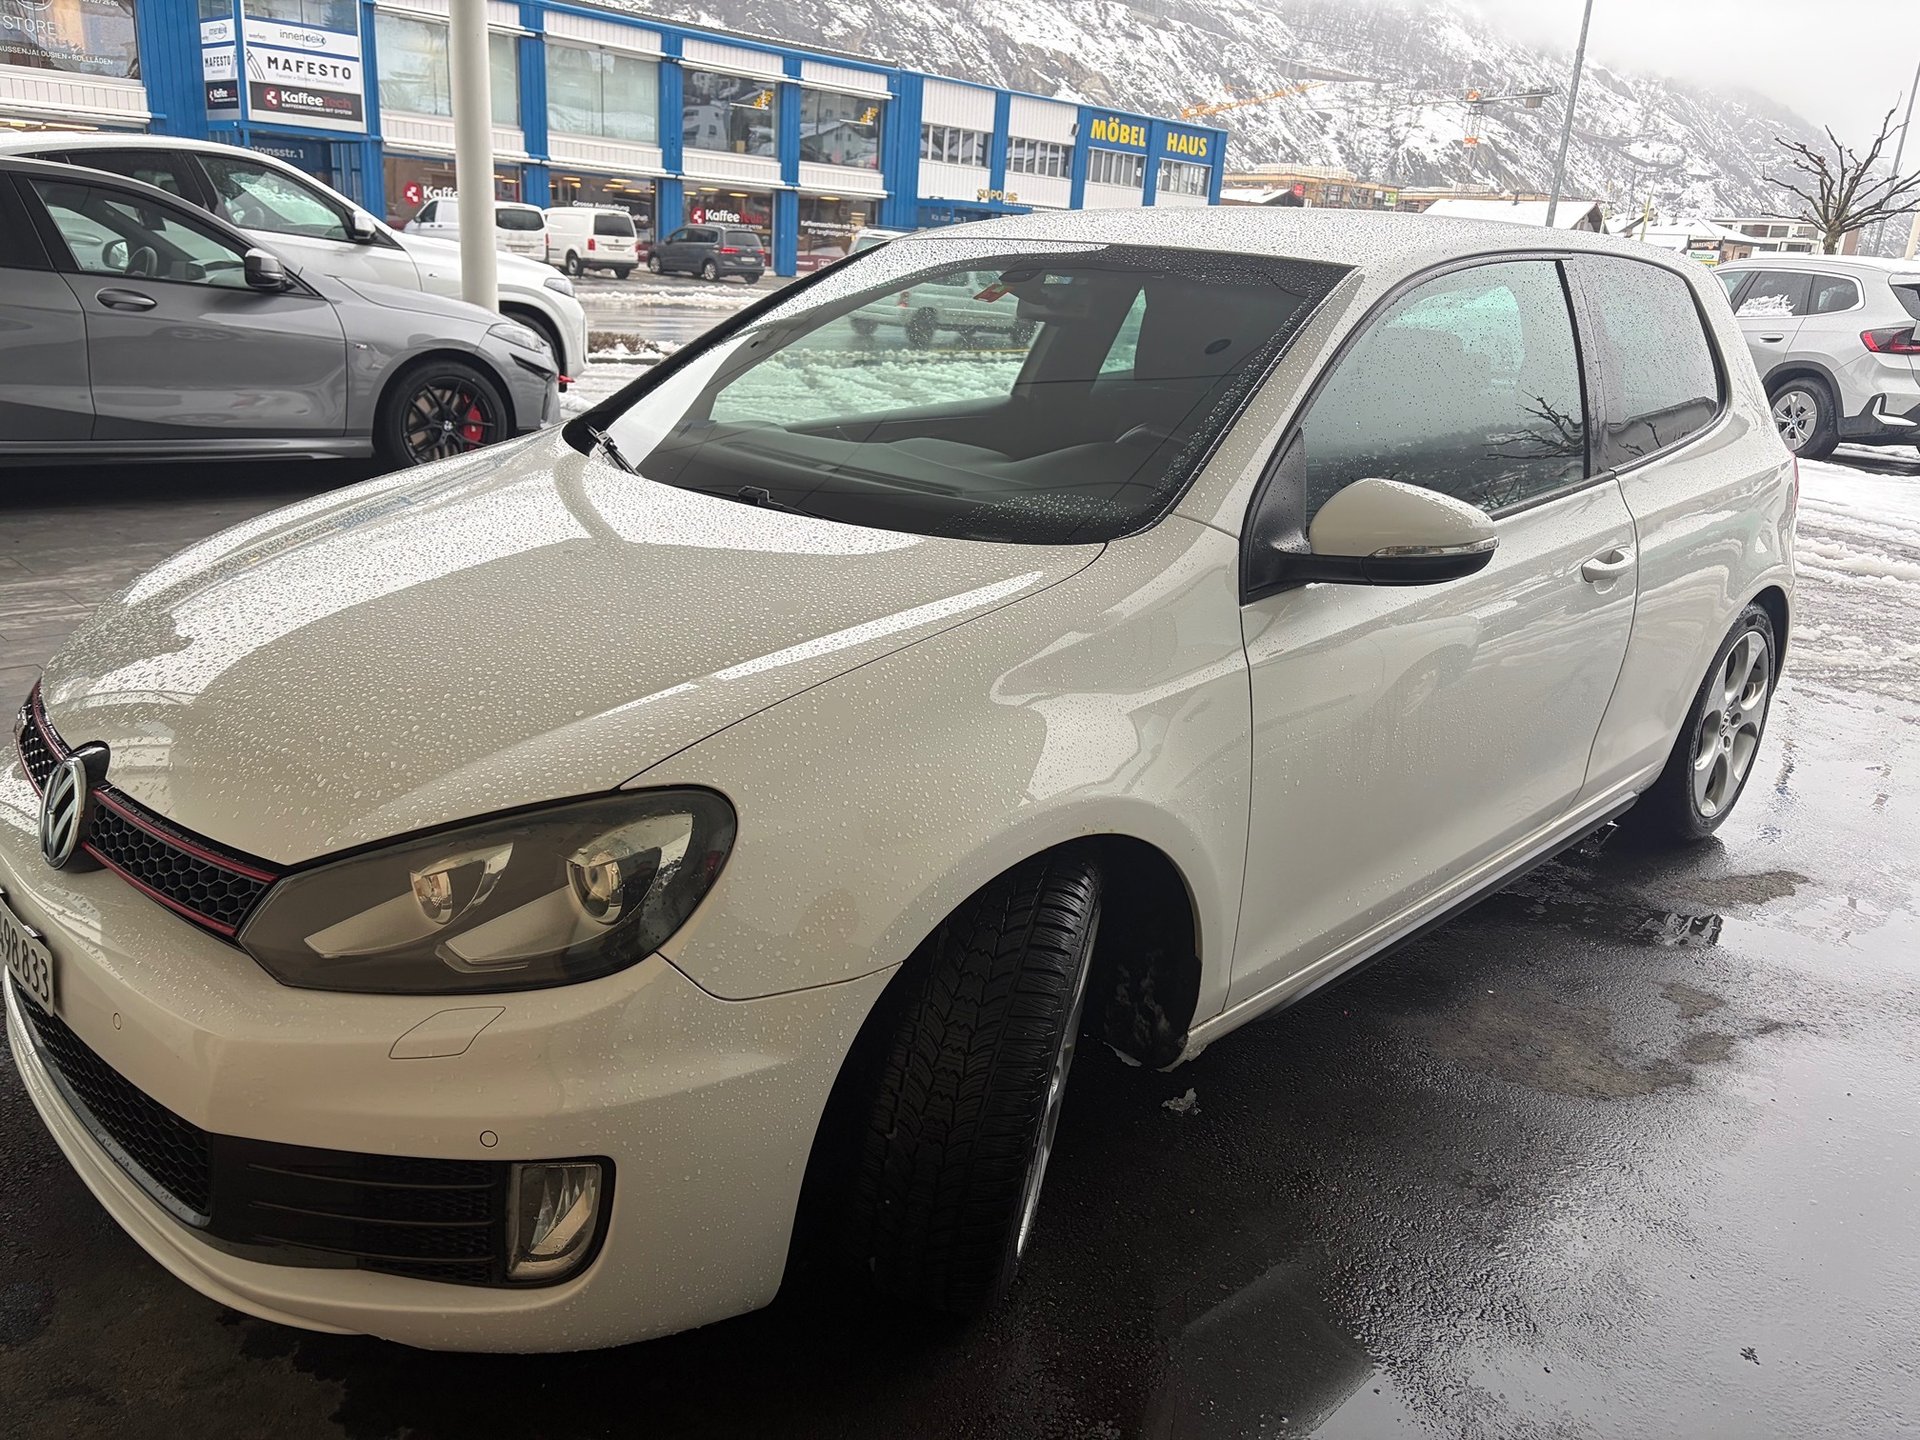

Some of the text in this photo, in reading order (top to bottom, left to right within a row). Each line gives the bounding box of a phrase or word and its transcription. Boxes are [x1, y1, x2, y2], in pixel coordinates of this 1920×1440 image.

[3, 15, 57, 36] STORE
[204, 55, 231, 67] MAFESTO
[267, 56, 352, 80] MAFESTO
[1090, 117, 1207, 157] MÖBEL HAUS
[298, 149, 304, 159] 1
[422, 185, 458, 199] Kaffe
